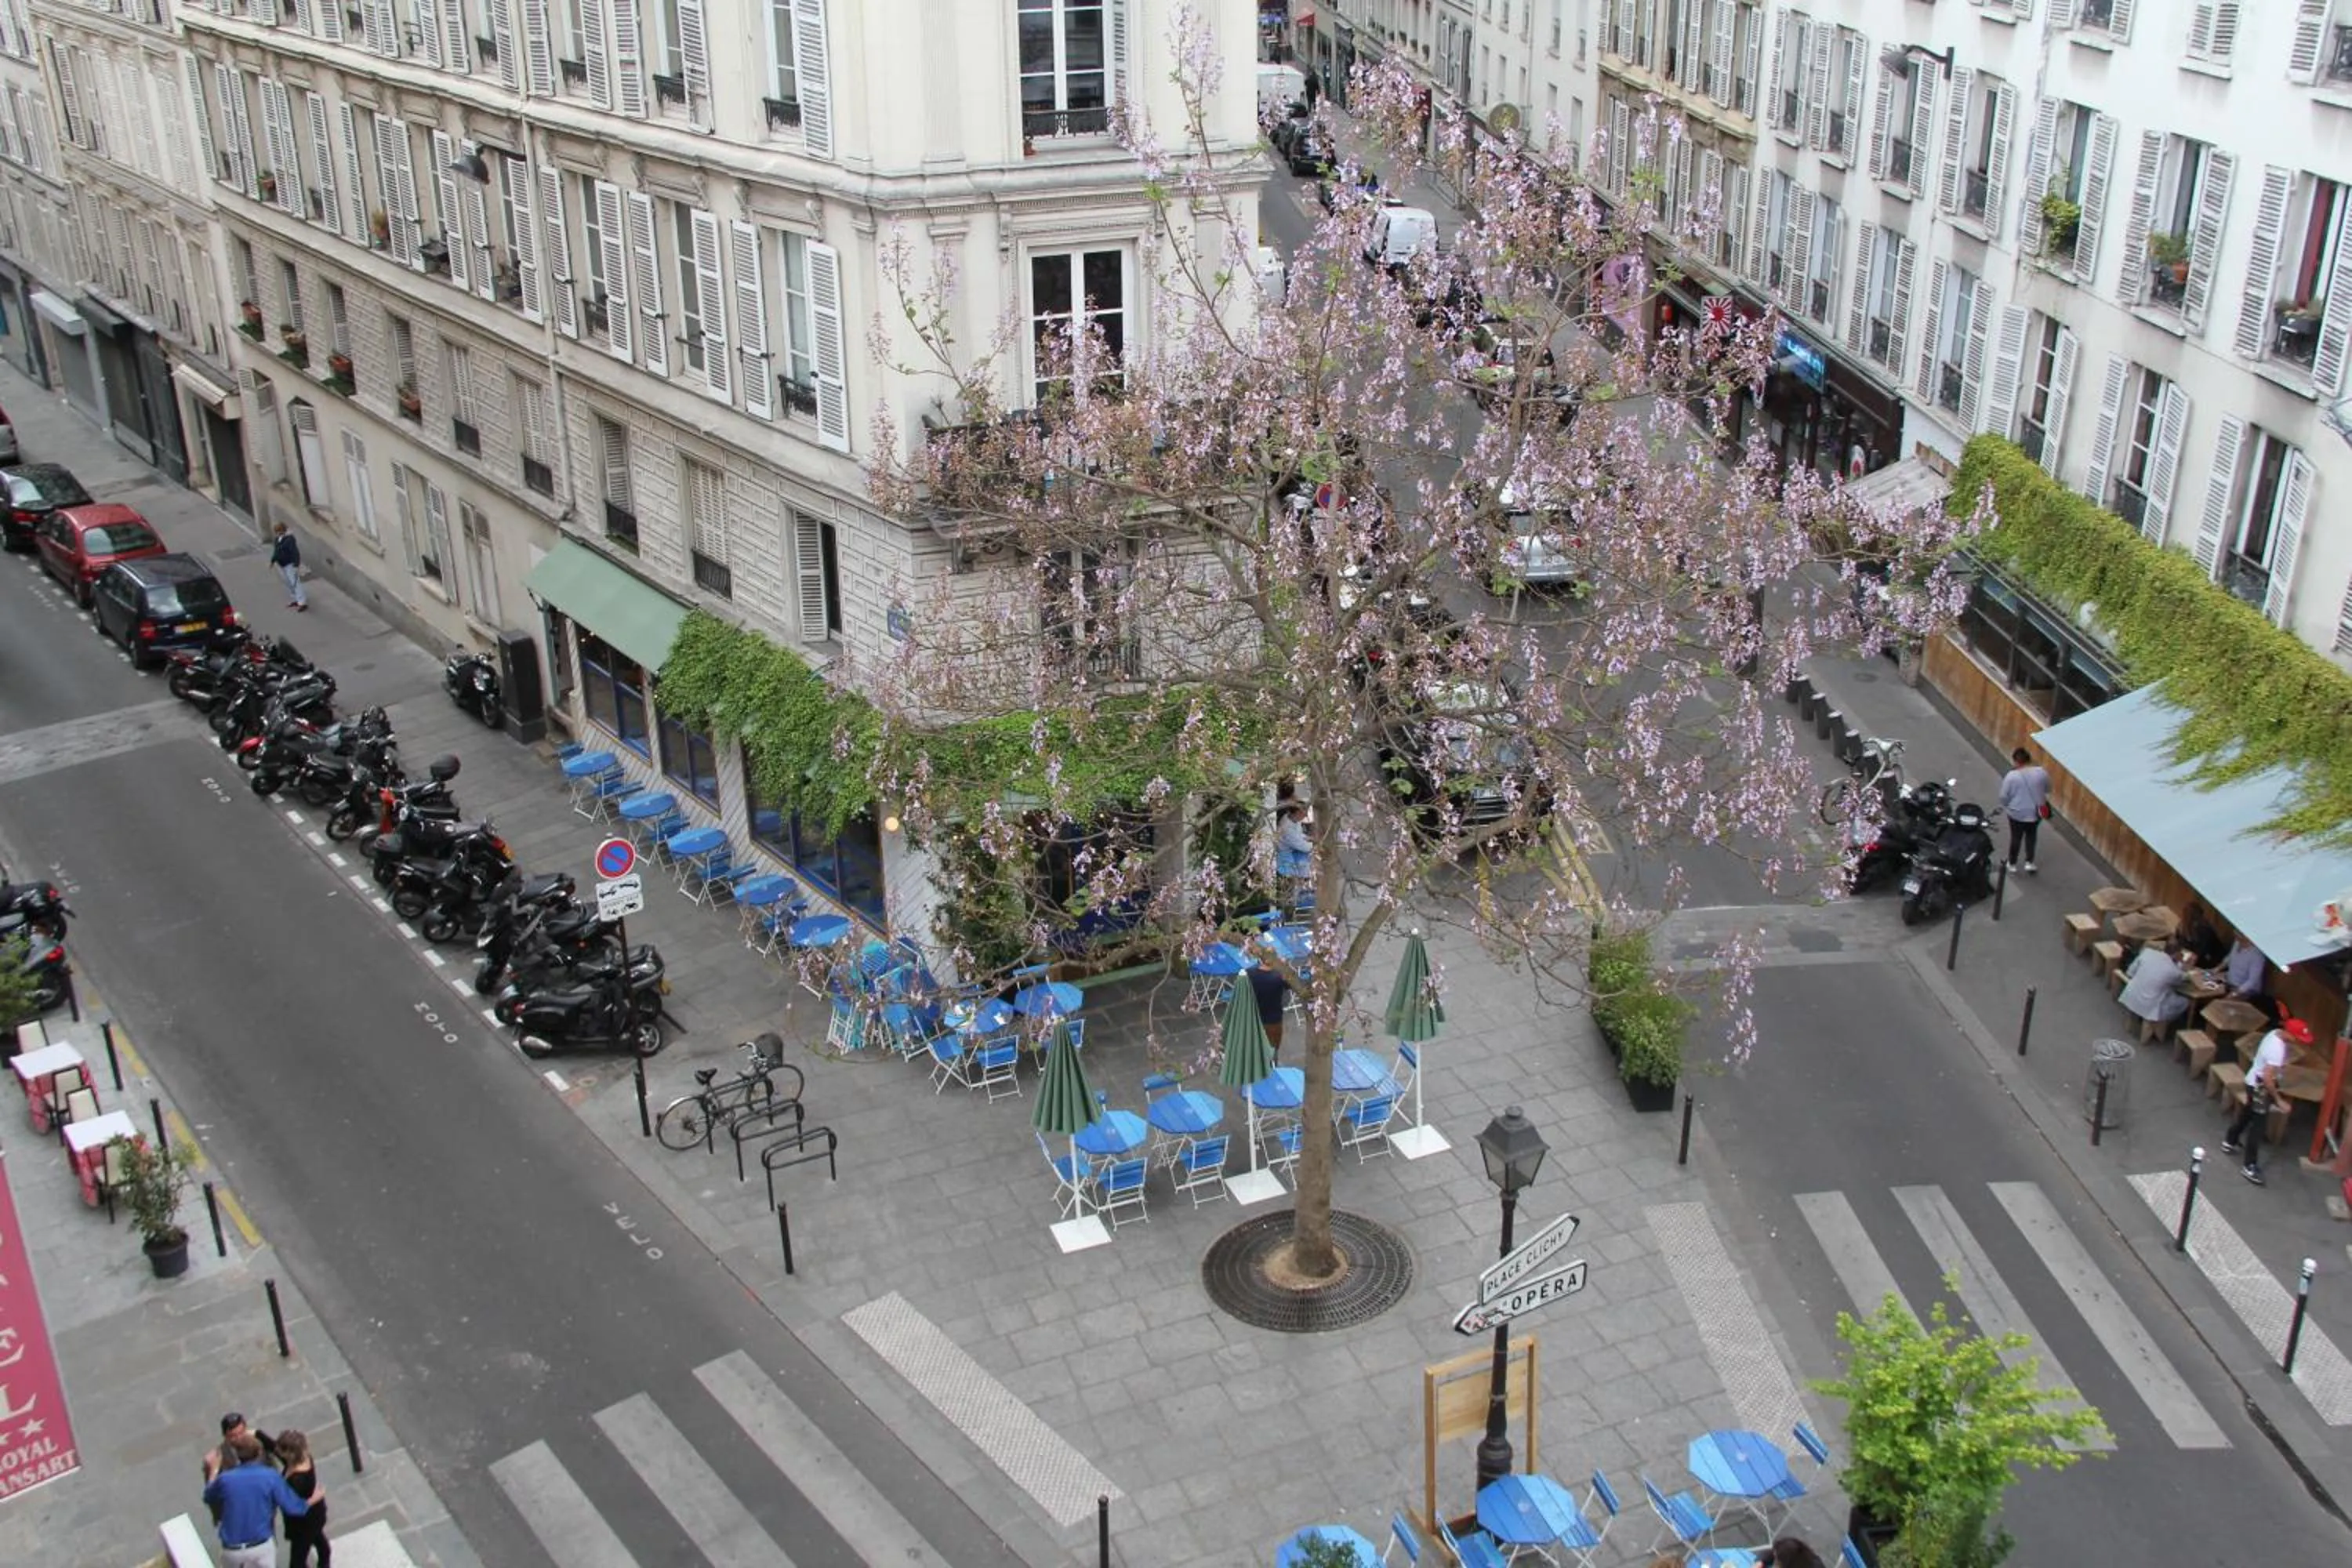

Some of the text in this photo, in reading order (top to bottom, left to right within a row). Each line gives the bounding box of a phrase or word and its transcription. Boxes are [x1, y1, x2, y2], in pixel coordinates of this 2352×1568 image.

[413, 1001, 459, 1044] MOTO
[603, 1201, 664, 1260] VELO
[1486, 1229, 1565, 1291] PLACE CLICHY
[1511, 1272, 1577, 1310] OPÉRA
[0, 1436, 58, 1473] OYAL
